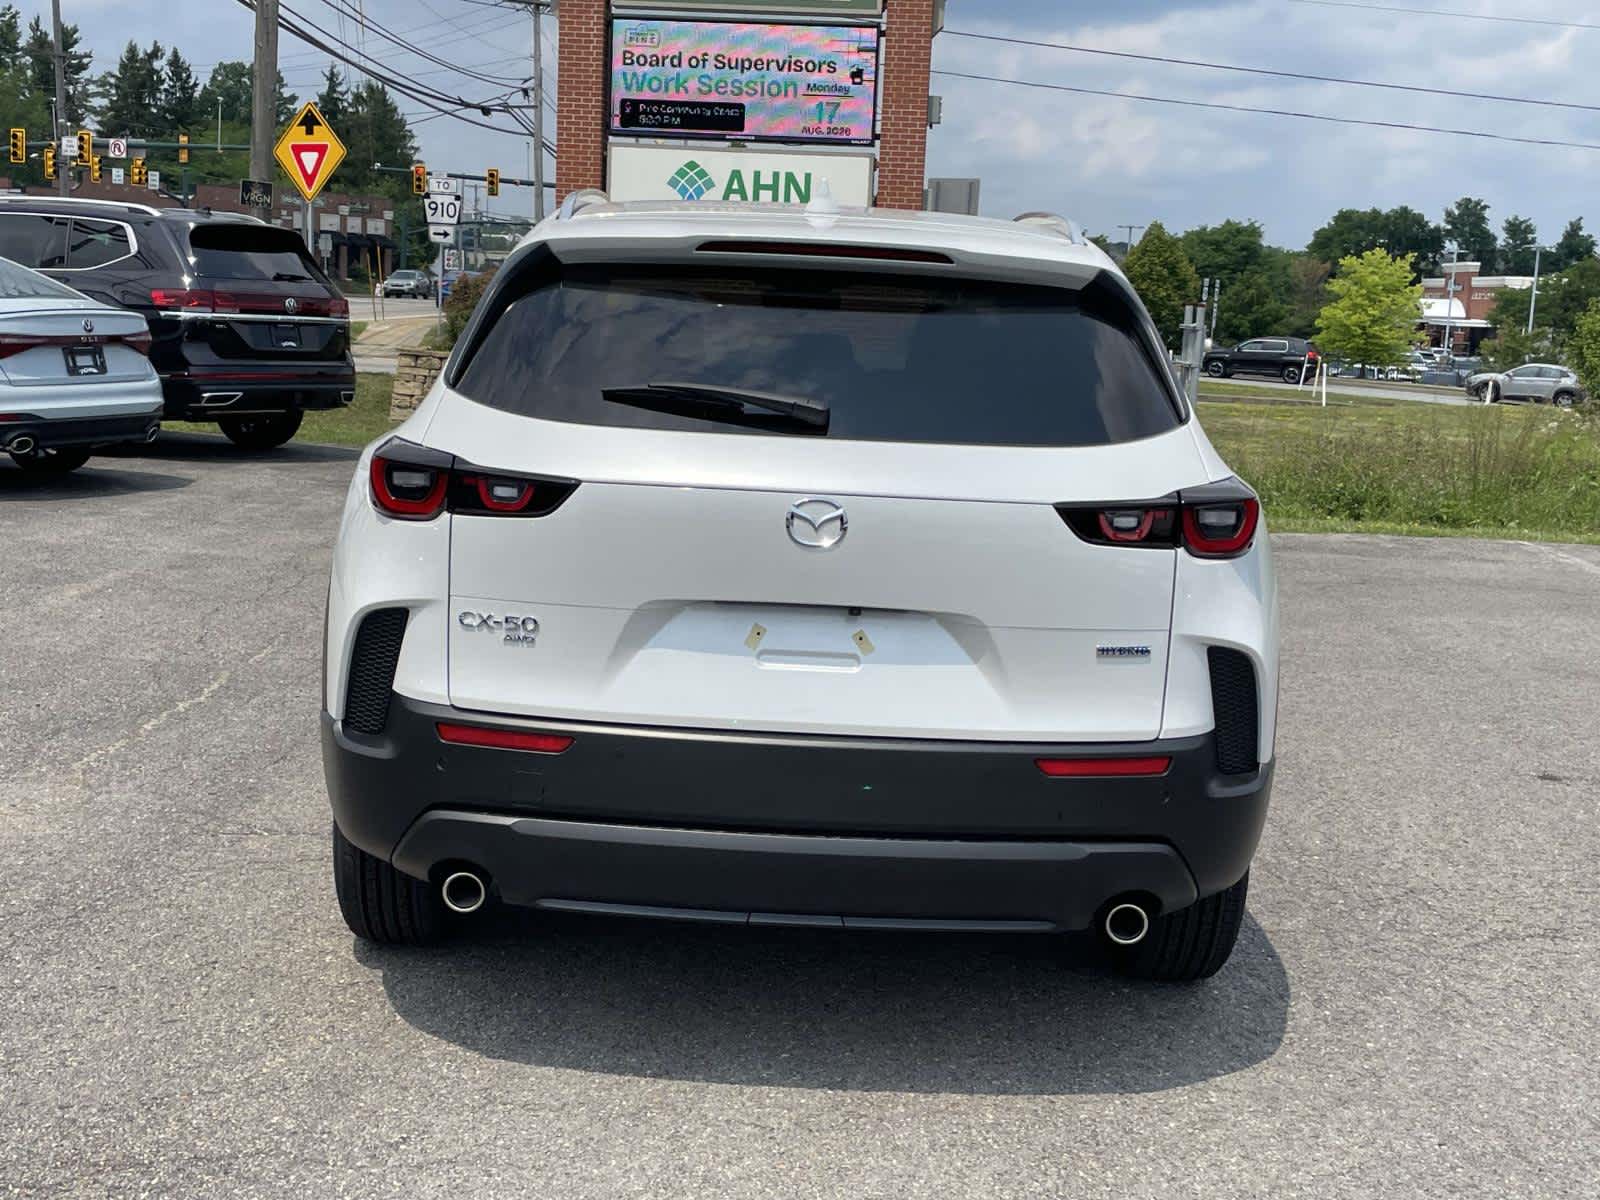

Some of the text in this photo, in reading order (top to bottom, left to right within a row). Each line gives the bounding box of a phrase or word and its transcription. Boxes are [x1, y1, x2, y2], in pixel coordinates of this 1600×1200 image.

[622, 50, 837, 74] Board of Supervisors
[622, 72, 798, 98] Work Session
[806, 83, 851, 94] Monday
[816, 101, 841, 124] 17
[801, 126, 825, 136] AUG.
[436, 181, 450, 190] TO
[722, 169, 812, 204] AHN
[243, 192, 271, 205] VRGN
[428, 201, 457, 218] 910
[458, 611, 539, 633] CX-50
[503, 634, 536, 647] AWD
